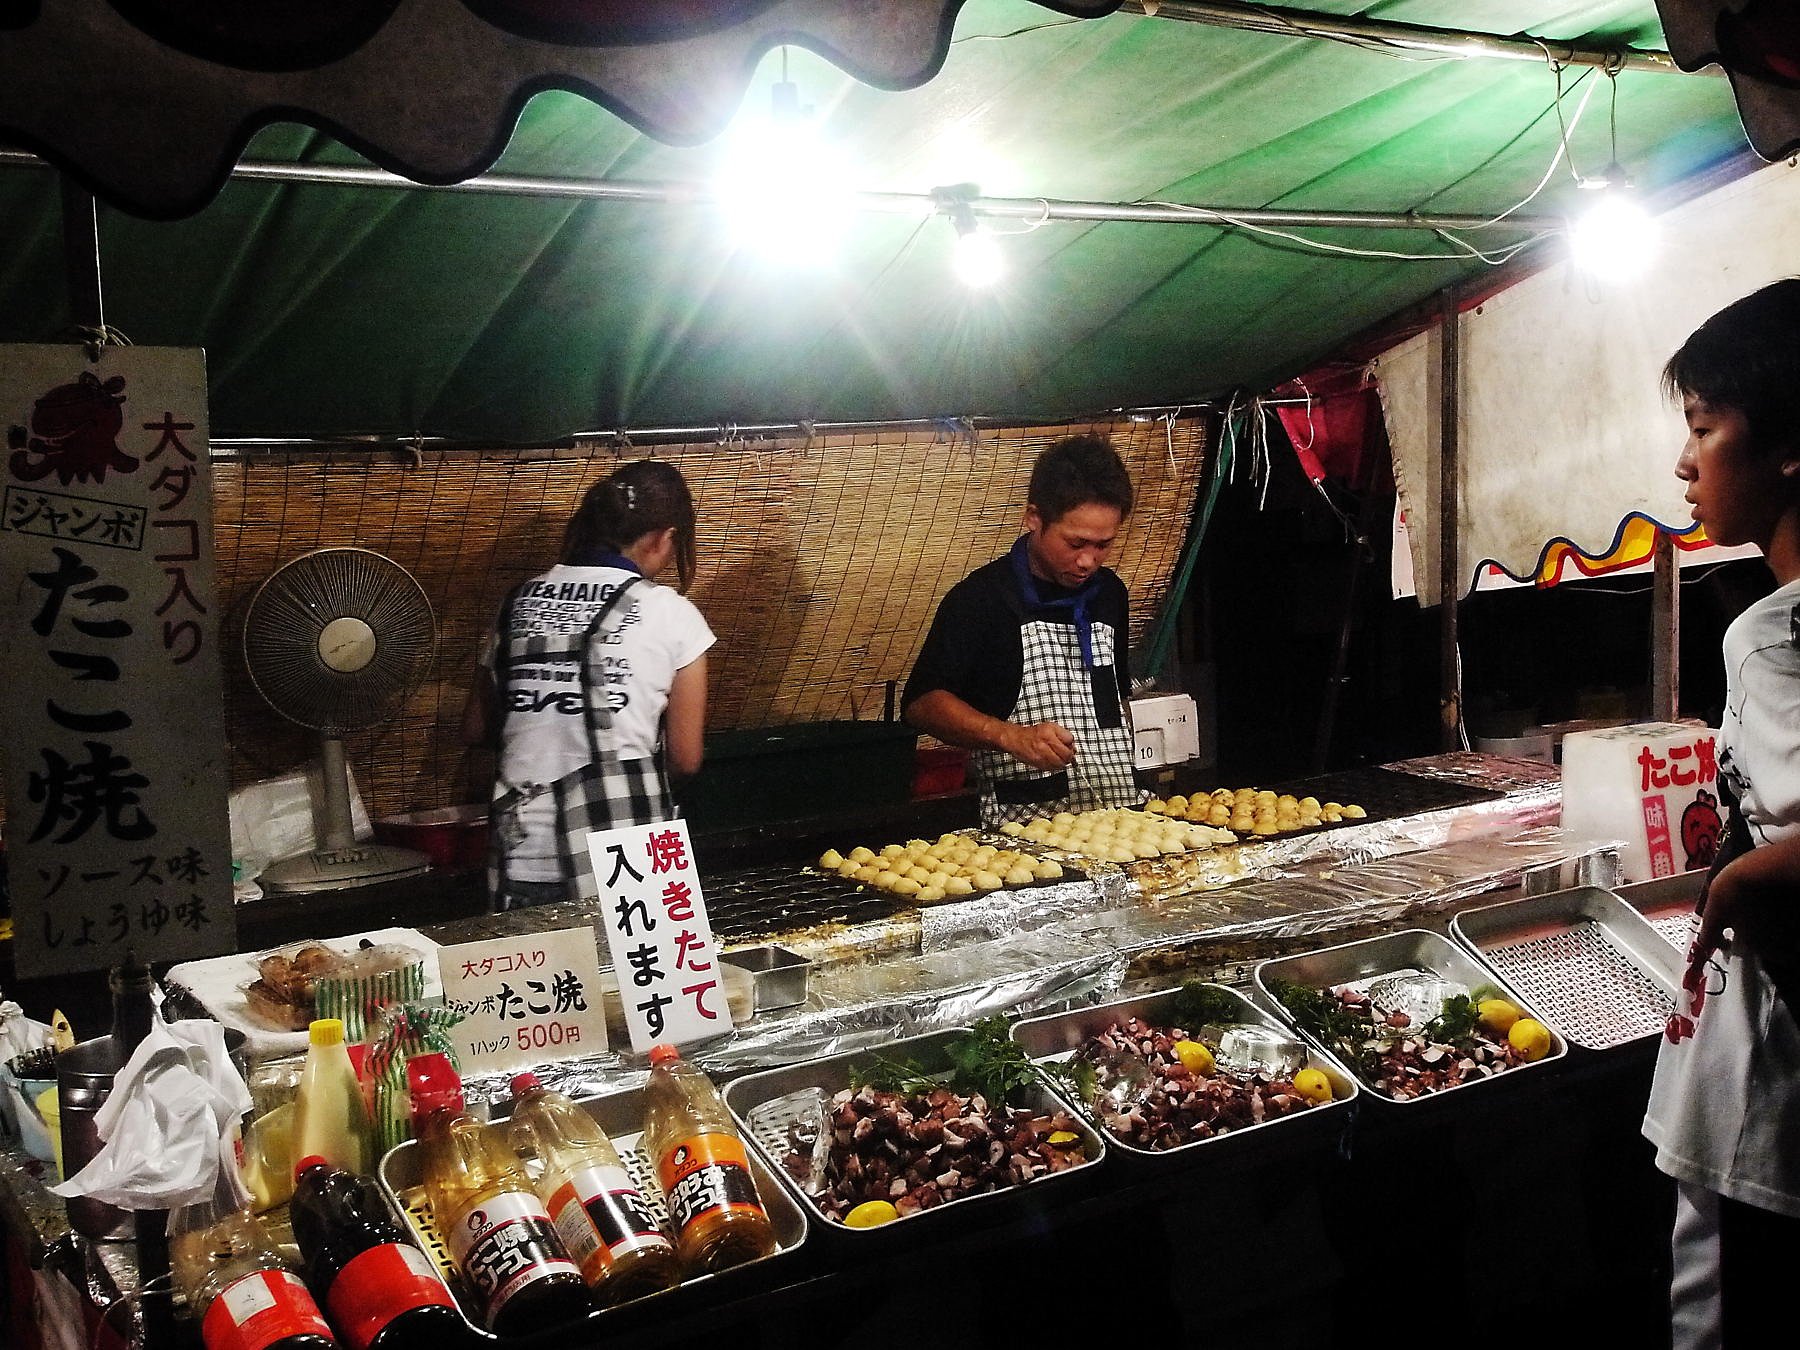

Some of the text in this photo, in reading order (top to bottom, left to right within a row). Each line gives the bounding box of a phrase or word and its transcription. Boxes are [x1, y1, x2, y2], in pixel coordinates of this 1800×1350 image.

[10, 495, 139, 544] ジャンボ
[143, 411, 207, 666] 大ダコ入り
[27, 546, 158, 845] たこ焼
[1139, 746, 1153, 760] 10
[37, 847, 210, 899] ソース味
[44, 893, 211, 948] しょうゆ味
[605, 844, 674, 1040] 入れます
[645, 829, 719, 1020] 焼きたて
[461, 950, 546, 980] 大ダコ入り
[517, 1021, 581, 1051] 500円
